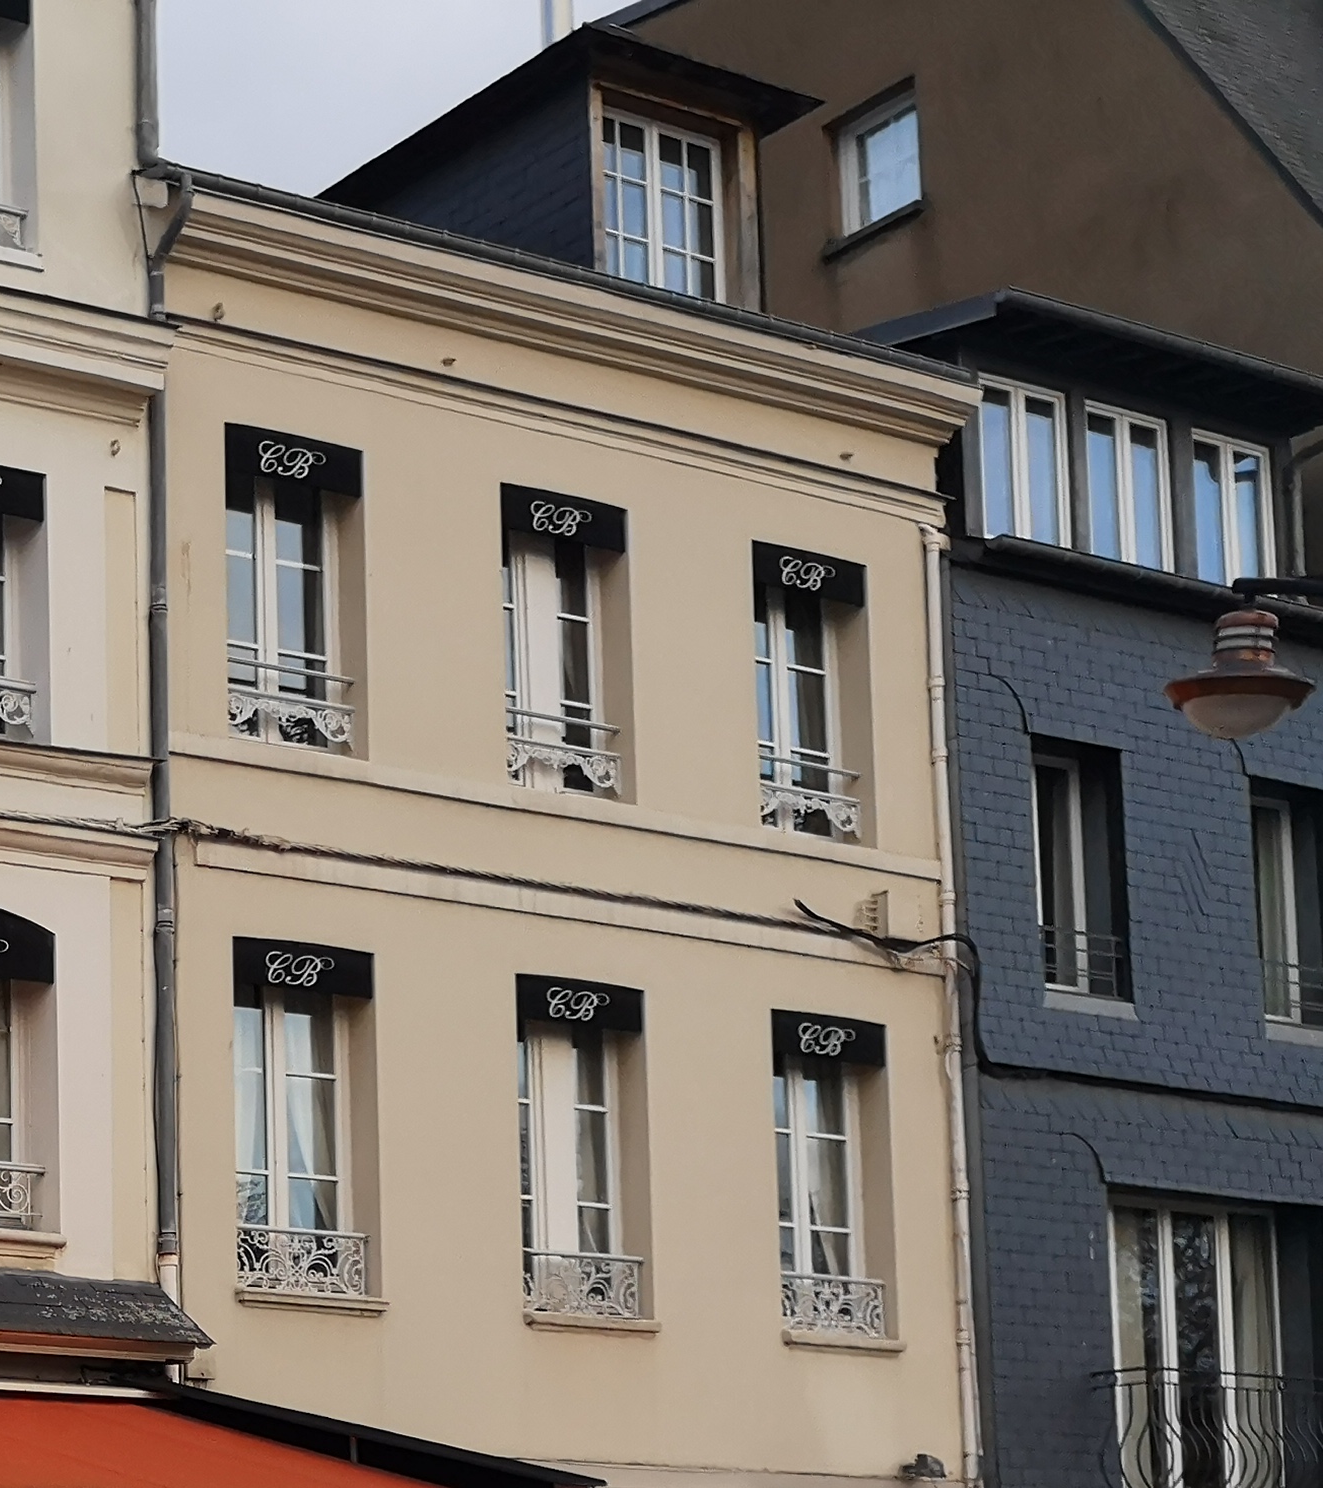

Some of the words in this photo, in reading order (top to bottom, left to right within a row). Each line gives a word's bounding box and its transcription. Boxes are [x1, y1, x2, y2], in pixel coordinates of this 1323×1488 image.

[259, 441, 326, 478] CB
[531, 501, 591, 536] CB
[780, 556, 835, 591] CB
[266, 951, 334, 986] CB
[547, 987, 609, 1021] CB
[799, 1023, 855, 1056] CB
